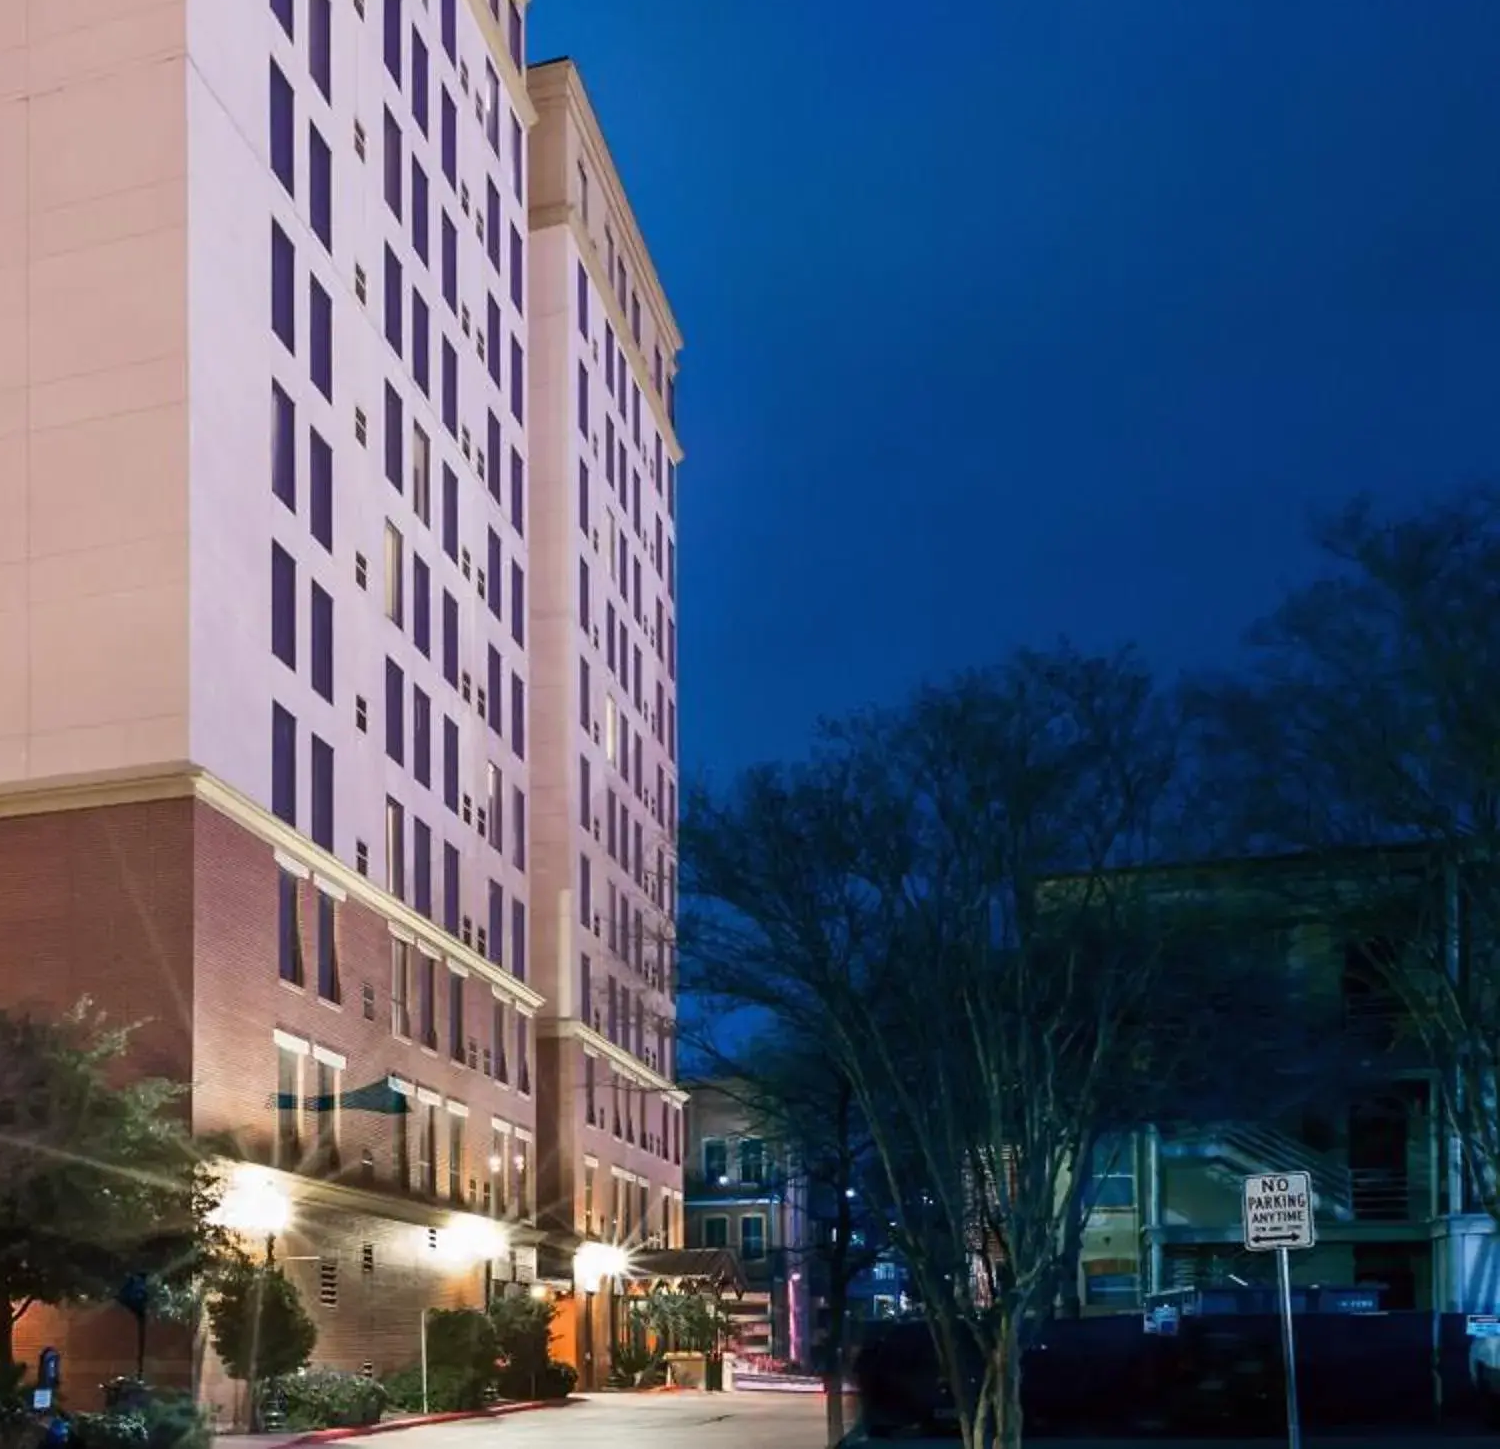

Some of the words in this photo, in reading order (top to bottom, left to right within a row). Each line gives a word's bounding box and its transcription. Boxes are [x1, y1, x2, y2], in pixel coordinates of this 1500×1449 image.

[1261, 1178, 1289, 1192] NO
[1248, 1193, 1306, 1209] PARKING
[1252, 1210, 1305, 1223] ANYTIME
